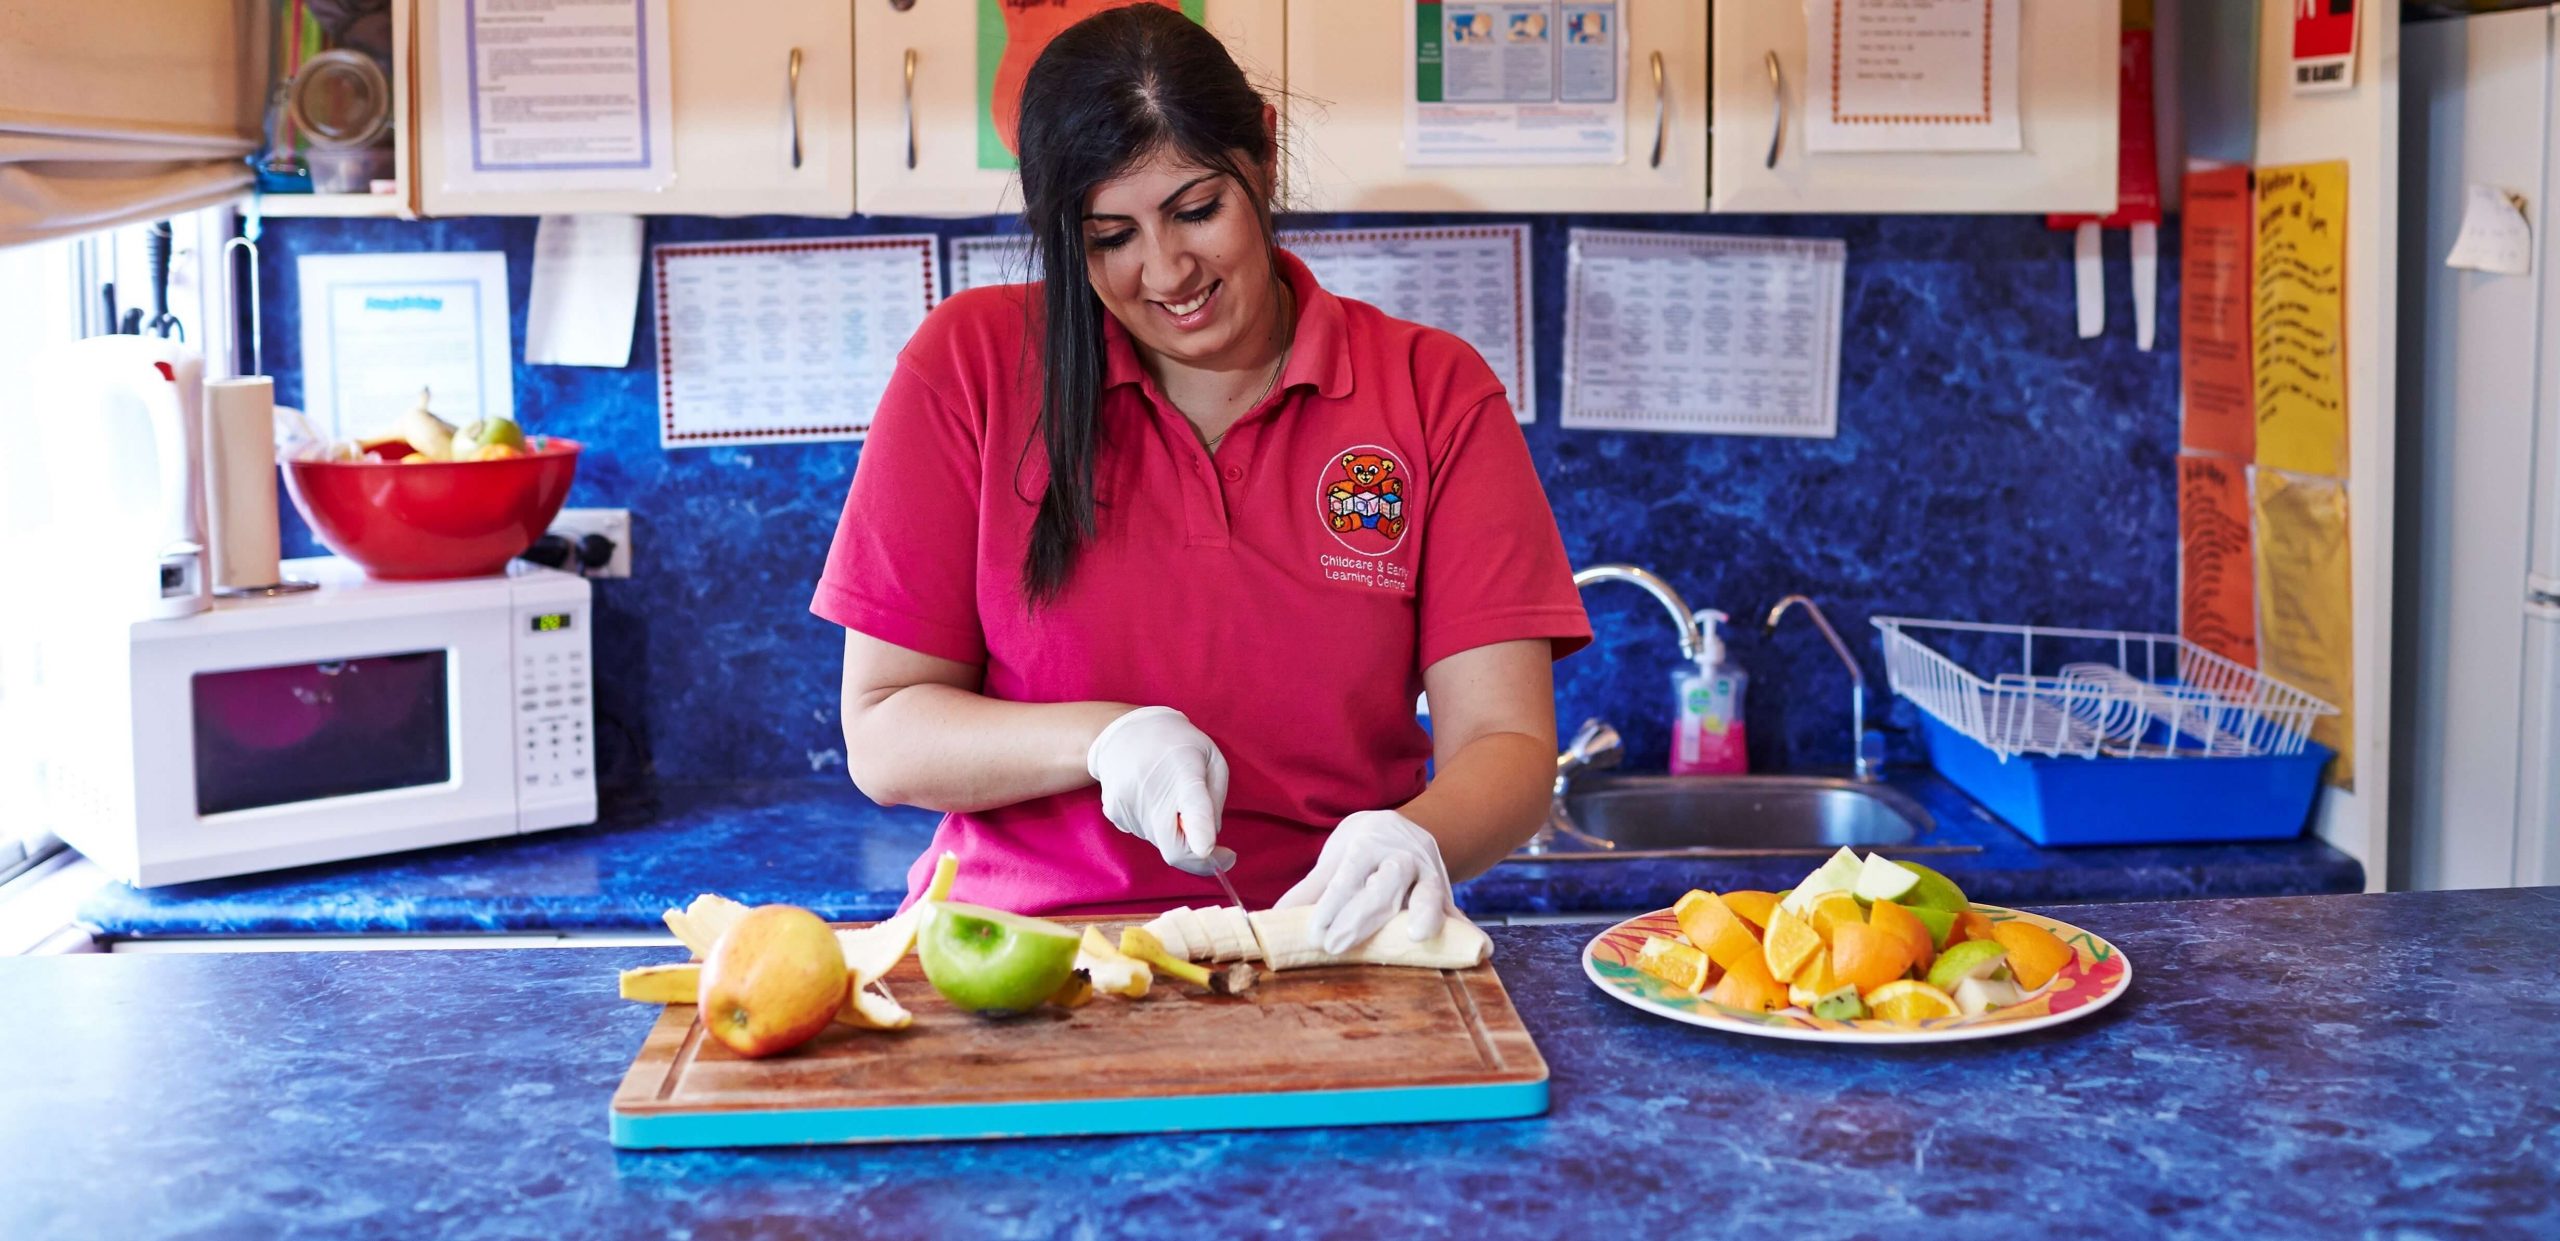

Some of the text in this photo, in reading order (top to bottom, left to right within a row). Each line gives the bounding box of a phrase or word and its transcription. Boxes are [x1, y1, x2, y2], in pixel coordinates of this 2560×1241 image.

[1320, 554, 1373, 571] Childcare
[1376, 560, 1384, 573] &
[1325, 568, 1406, 591] Learning Centre
